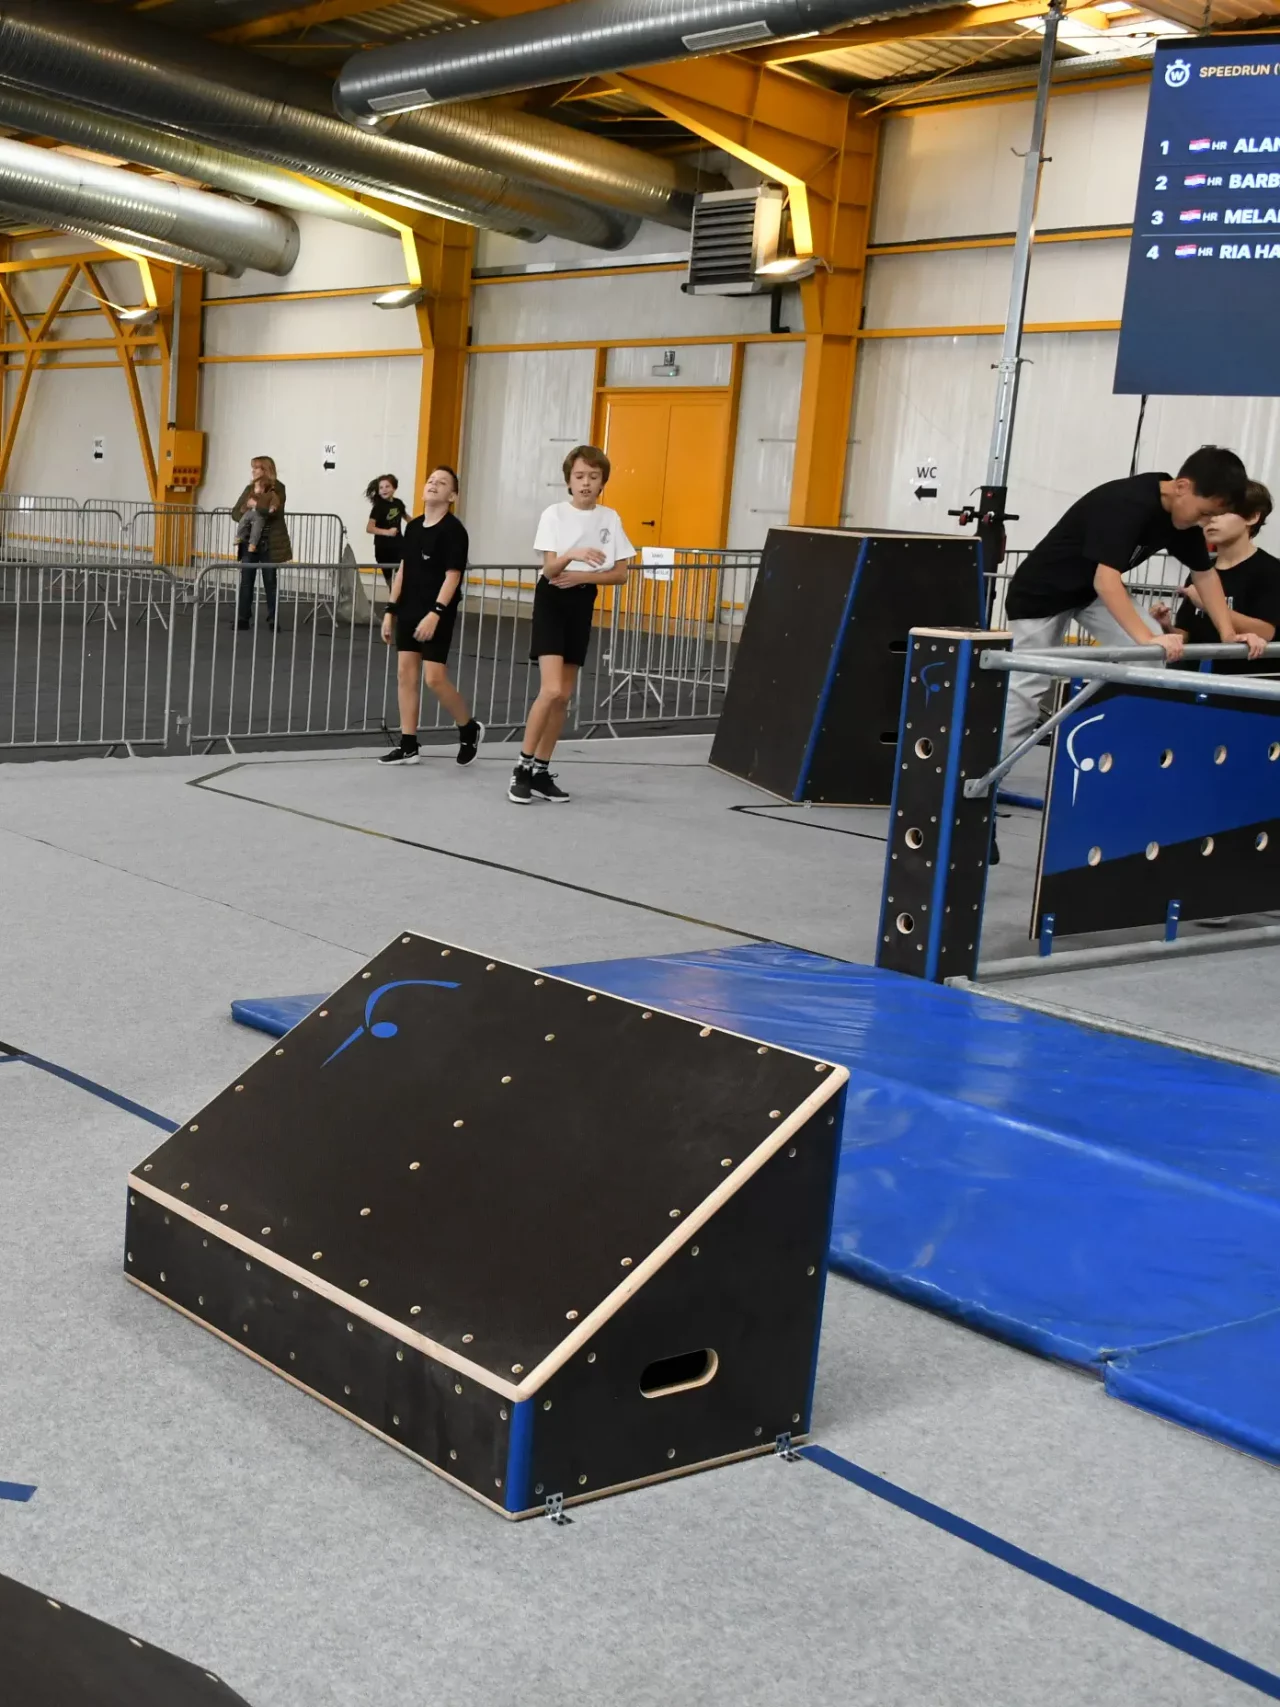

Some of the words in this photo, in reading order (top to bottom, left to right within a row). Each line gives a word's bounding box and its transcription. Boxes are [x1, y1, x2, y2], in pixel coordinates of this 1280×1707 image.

[1199, 64, 1271, 78] SPEEDRUN
[1160, 140, 1170, 155] 1
[1211, 141, 1228, 150] HR
[1155, 175, 1168, 190] 2
[1207, 177, 1223, 186] HR
[1229, 173, 1280, 189] BARB
[1151, 210, 1164, 225] 3
[1202, 212, 1218, 221] HR
[1224, 208, 1280, 224] MELA
[1146, 245, 1159, 260] 4
[1197, 247, 1213, 256] HR
[1219, 244, 1251, 259] RIA
[324, 444, 336, 454] WC
[916, 466, 938, 479] WC
